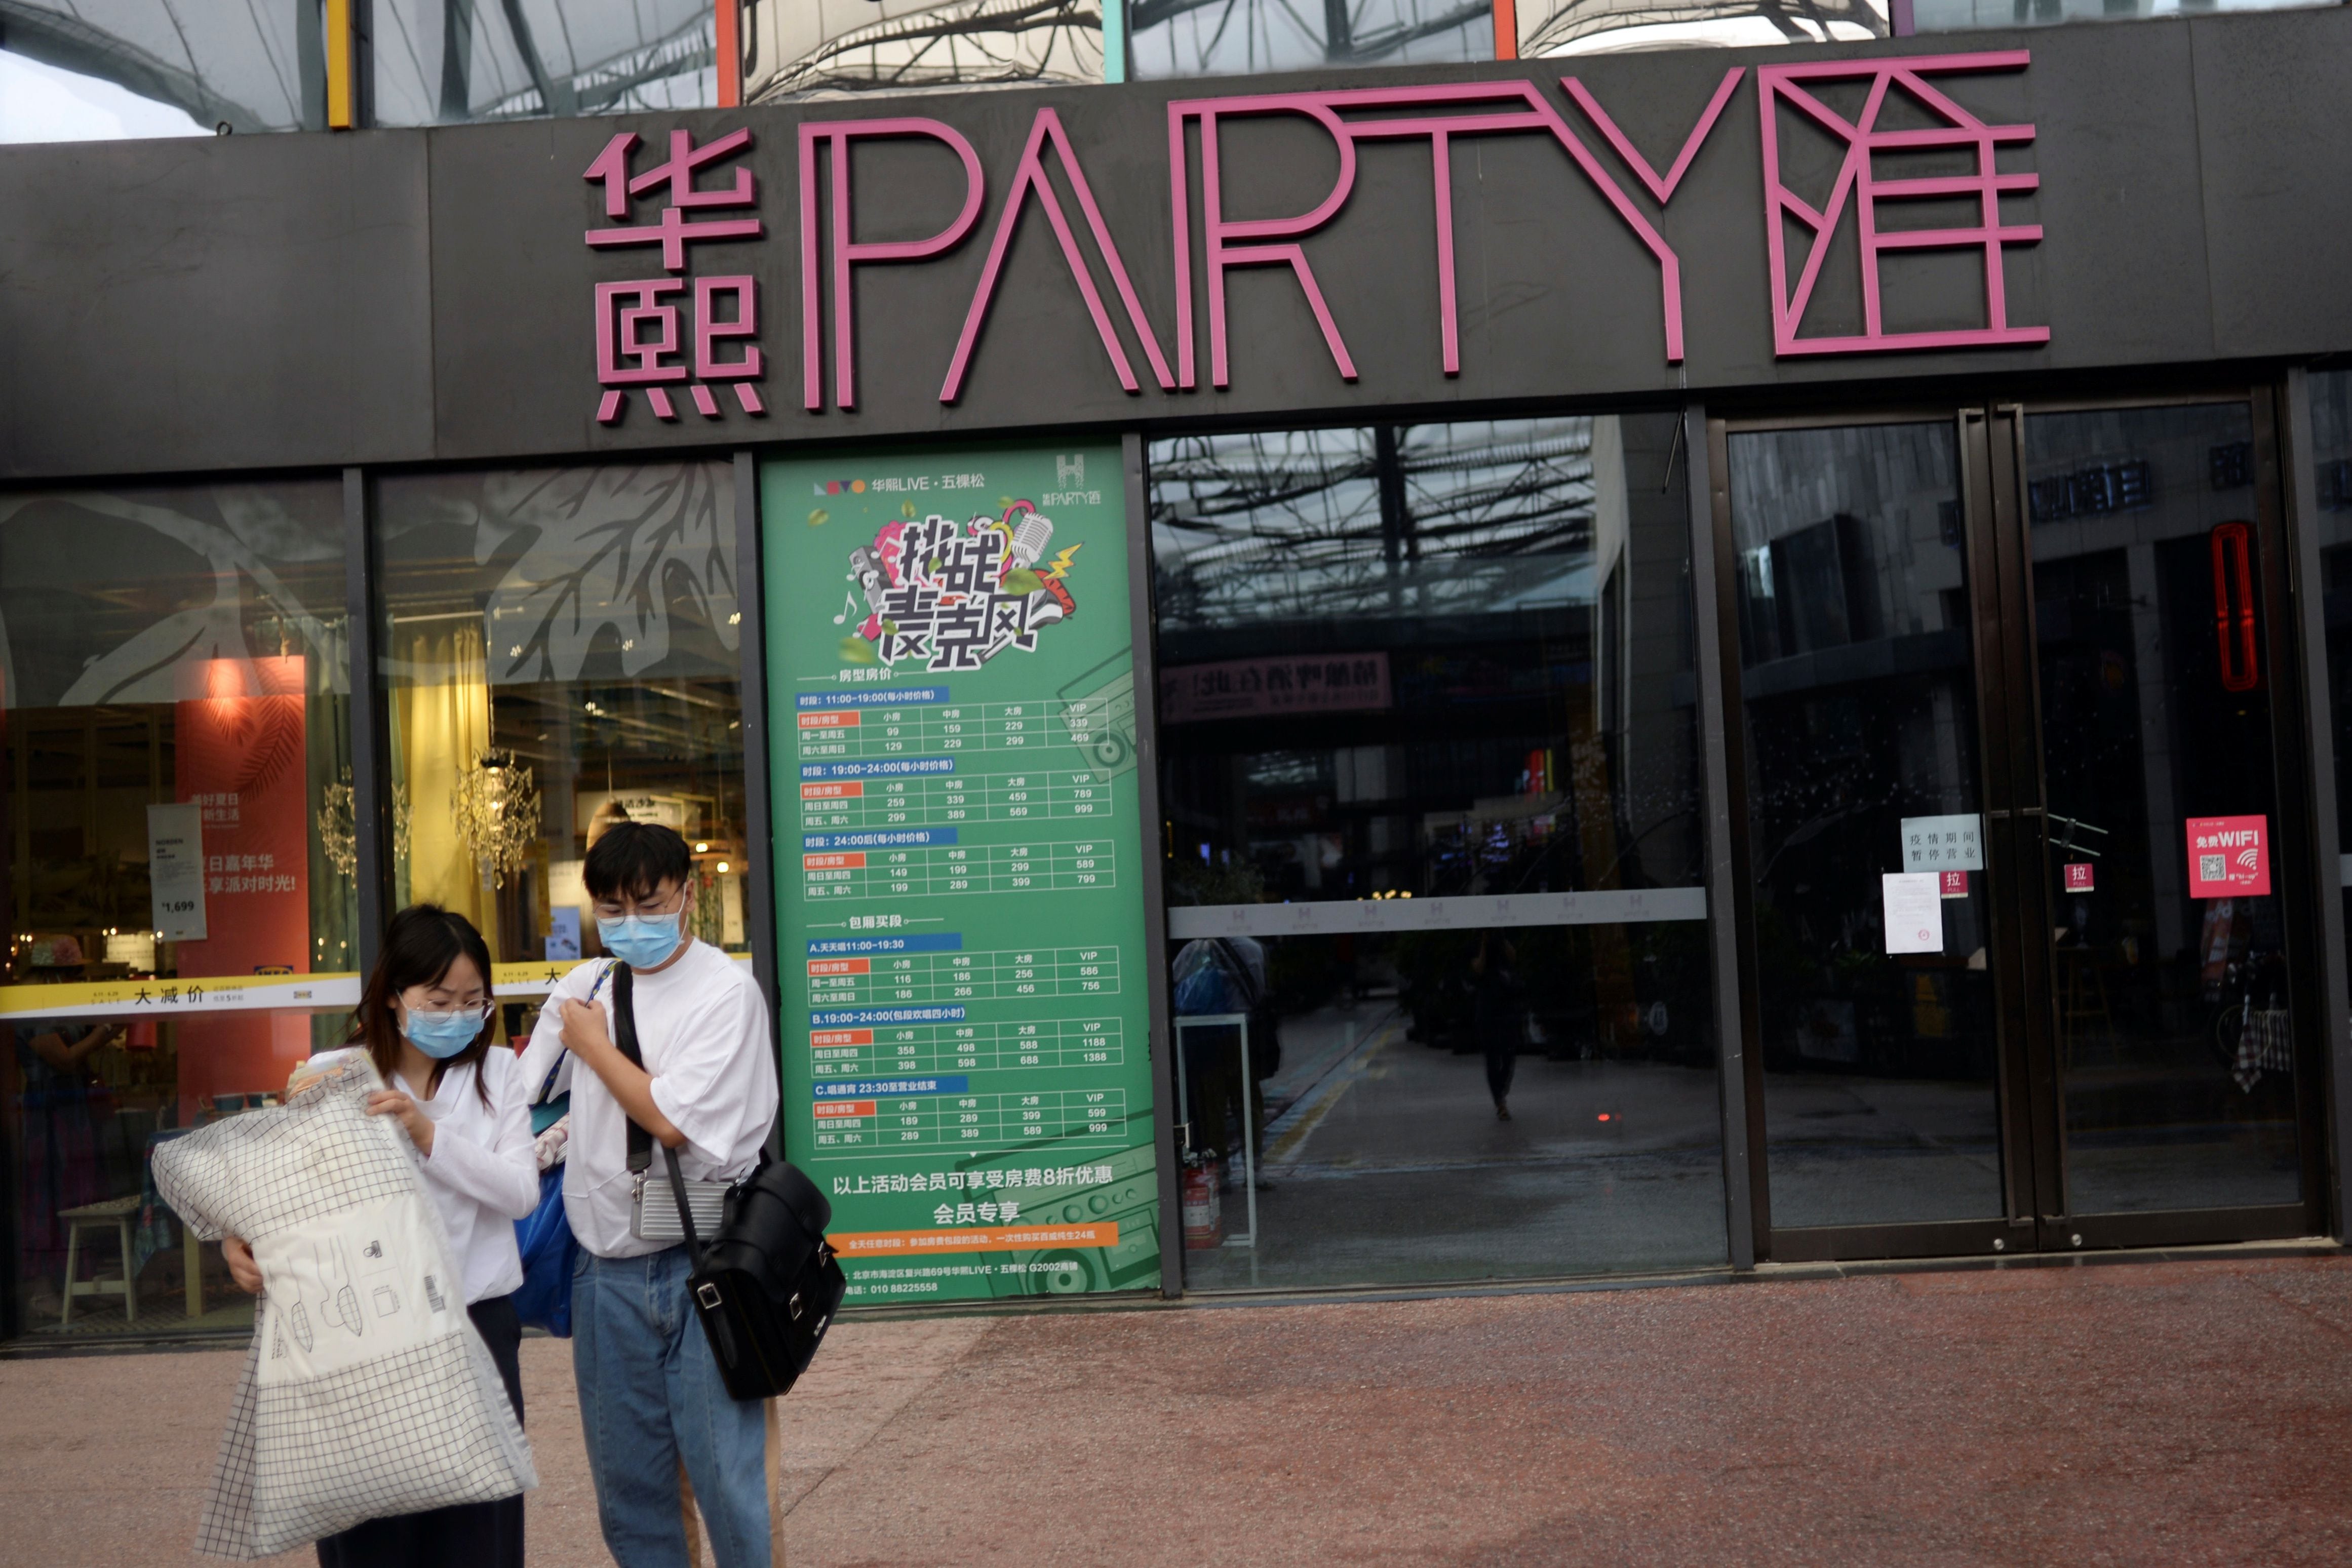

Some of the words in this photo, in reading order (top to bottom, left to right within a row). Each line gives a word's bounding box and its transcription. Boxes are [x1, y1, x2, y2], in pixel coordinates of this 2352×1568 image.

[839, 667, 892, 683] 房型房价
[883, 712, 900, 722] 小房
[943, 709, 960, 719] 中房
[1005, 706, 1022, 716] 大房
[1069, 703, 1087, 713] VIP
[802, 729, 845, 740] 周一至周五
[887, 727, 899, 736] 99
[944, 724, 961, 733] 159
[1005, 721, 1023, 730] 229
[1070, 718, 1088, 728] 339
[802, 744, 845, 755] 周六至周日
[885, 741, 903, 751] 129
[944, 739, 962, 748] 229
[1006, 736, 1024, 746] 299
[1071, 732, 1089, 742] 469
[886, 782, 904, 793] 小房
[946, 779, 963, 790] 中房
[1008, 777, 1025, 787] 大房
[1072, 774, 1090, 783] VIP
[805, 800, 848, 811] 周日至周四
[887, 798, 905, 807] 259
[947, 795, 964, 804] 339
[1008, 792, 1027, 801] 459
[1074, 789, 1092, 798] 789
[805, 815, 848, 826] 周五、周六
[888, 812, 906, 822] 299
[948, 809, 965, 819] 389
[1010, 807, 1028, 816] 569
[1075, 804, 1093, 813] 999
[1910, 831, 1974, 846] 疫情期间
[203, 854, 274, 873] 日嘉年华
[889, 852, 907, 863] 小房
[948, 850, 966, 859] 中房
[1010, 847, 1028, 857] 大房
[1075, 844, 1093, 853] VIP
[1911, 847, 1975, 861] 暂停营业
[807, 870, 851, 881] 周日至周四
[890, 868, 908, 877] 149
[950, 865, 967, 874] 199
[1011, 862, 1029, 872] 299
[1076, 859, 1094, 869] 589
[1947, 872, 1961, 887] 拉
[2072, 866, 2086, 881] 拉
[204, 874, 296, 894] 享派对时光!
[808, 885, 851, 896] 周五、周六
[891, 883, 908, 892] 199
[950, 880, 968, 889] 289
[1012, 877, 1030, 886] 399
[1077, 874, 1095, 884] 799
[849, 914, 902, 929] 包厢买段
[893, 959, 911, 969] 小房
[953, 957, 970, 966] 中房
[1015, 954, 1033, 964] 大房
[1080, 951, 1097, 961] VIP
[811, 977, 855, 988] 周一至周五
[894, 974, 911, 984] 116
[953, 972, 971, 981] 186
[1015, 969, 1033, 978] 256
[1080, 966, 1099, 975] 586
[134, 985, 205, 1005] 大减价
[812, 992, 855, 1003] 周六至周日
[895, 989, 913, 999] 186
[954, 987, 972, 996] 266
[1016, 984, 1035, 993] 456
[1082, 981, 1100, 991] 756
[896, 1030, 914, 1040] 小房
[956, 1028, 973, 1038] 中房
[1018, 1025, 1036, 1035] 大房
[1083, 1023, 1101, 1032] VIP
[814, 1048, 858, 1059] 周日至周四
[897, 1045, 915, 1055] 358
[957, 1043, 975, 1052] 498
[1020, 1040, 1038, 1050] 588
[1083, 1037, 1106, 1046] 1188
[815, 1063, 858, 1074] 周五、周六
[898, 1061, 916, 1070] 398
[958, 1058, 976, 1068] 598
[1020, 1055, 1039, 1065] 688
[1083, 1052, 1107, 1062] 1388
[899, 1101, 917, 1111] 小房
[959, 1098, 976, 1108] 中房
[1022, 1095, 1039, 1106] 大房
[1086, 1093, 1104, 1102] VIP
[817, 1118, 861, 1129] 周日至周四
[900, 1116, 918, 1125] 189
[960, 1113, 978, 1123] 289
[1023, 1111, 1041, 1120] 399
[1088, 1108, 1106, 1118] 599
[818, 1133, 861, 1145] 周五、周六
[901, 1131, 919, 1141] 289
[961, 1128, 979, 1138] 389
[1024, 1125, 1042, 1135] 589
[1089, 1123, 1107, 1132] 999
[833, 1165, 1113, 1195] 以上活动会员可享受房费8折优惠
[933, 1201, 1021, 1225] 会员专享
[890, 1283, 937, 1293] 88225558
